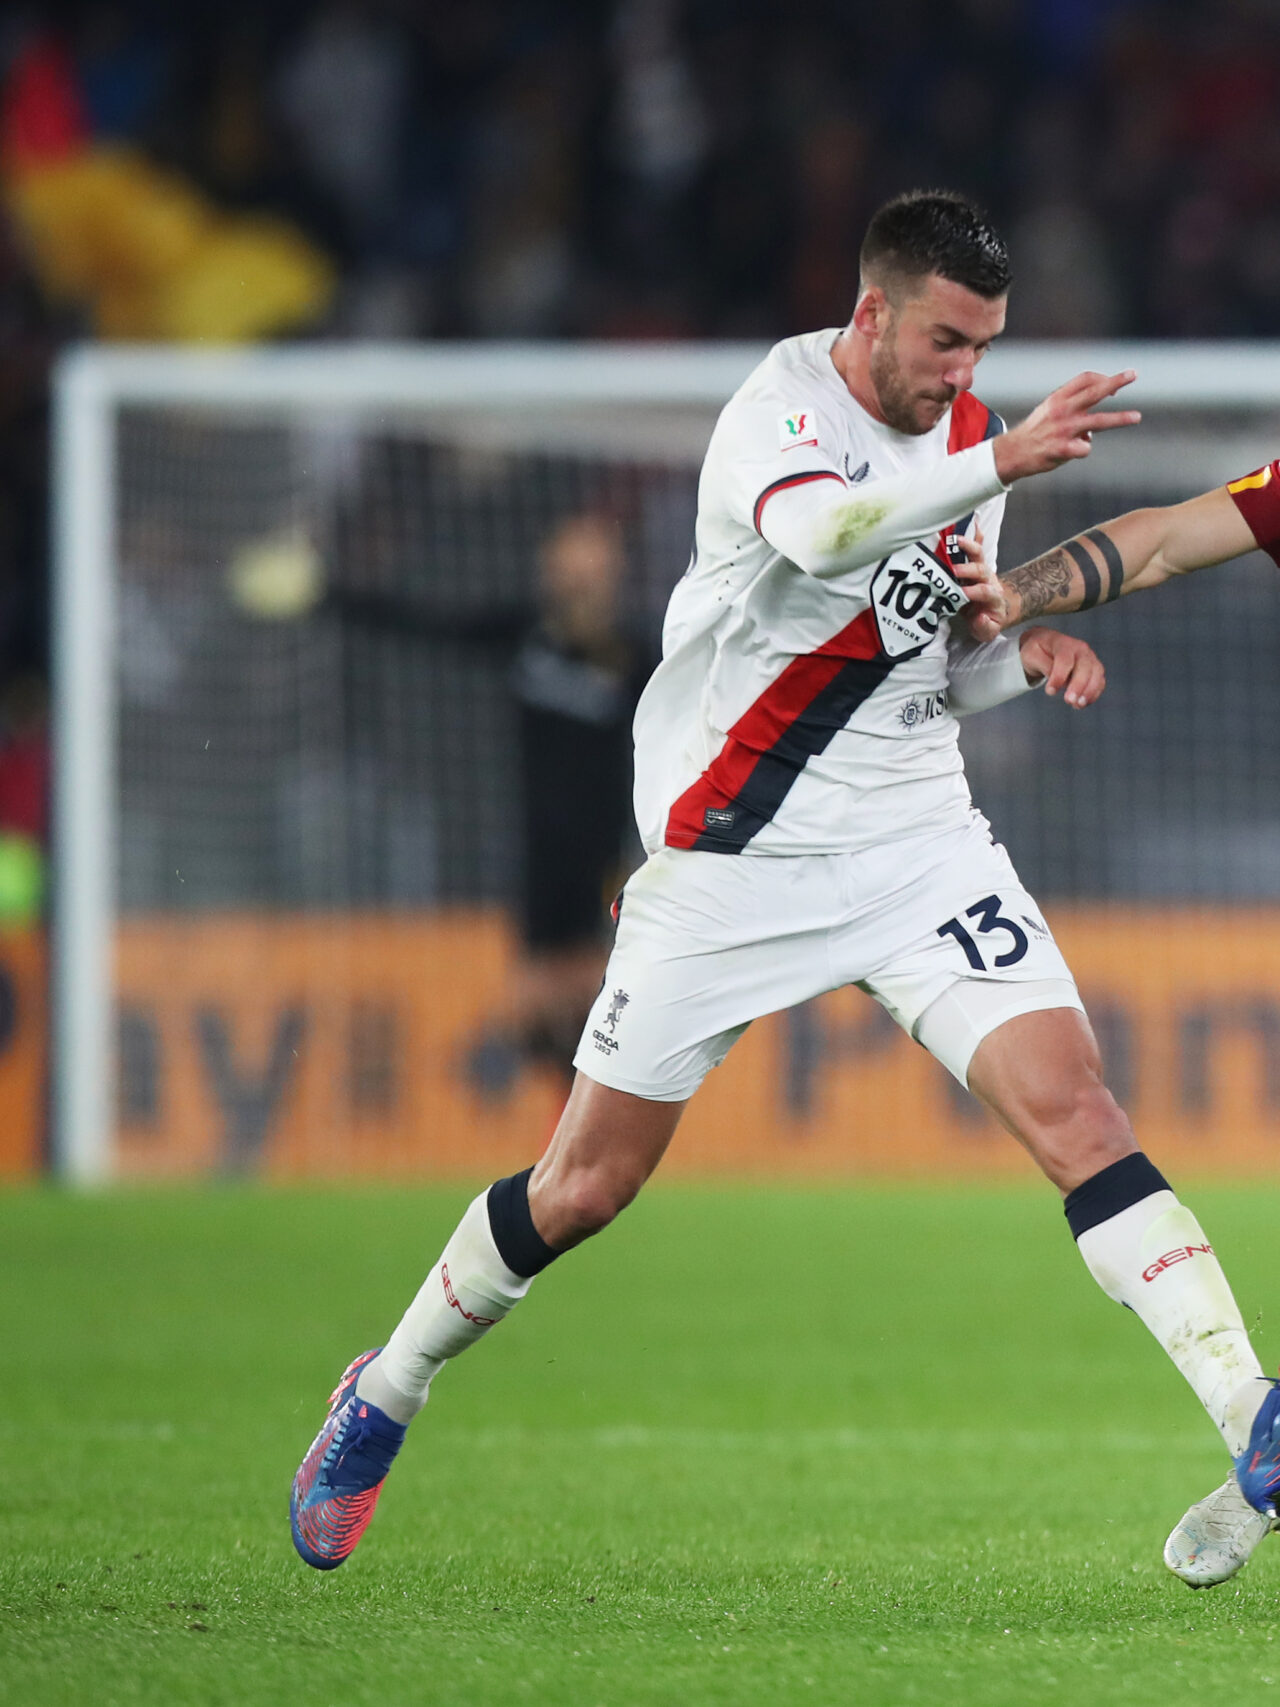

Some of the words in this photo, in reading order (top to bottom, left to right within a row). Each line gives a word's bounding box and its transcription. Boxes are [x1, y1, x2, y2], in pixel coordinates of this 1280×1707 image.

[879, 569, 957, 635] 105
[912, 557, 961, 603] RADIO
[881, 616, 920, 643] NETWORK
[936, 894, 1028, 972] 13
[592, 1029, 619, 1051] GENOA
[441, 1262, 504, 1326] GENO
